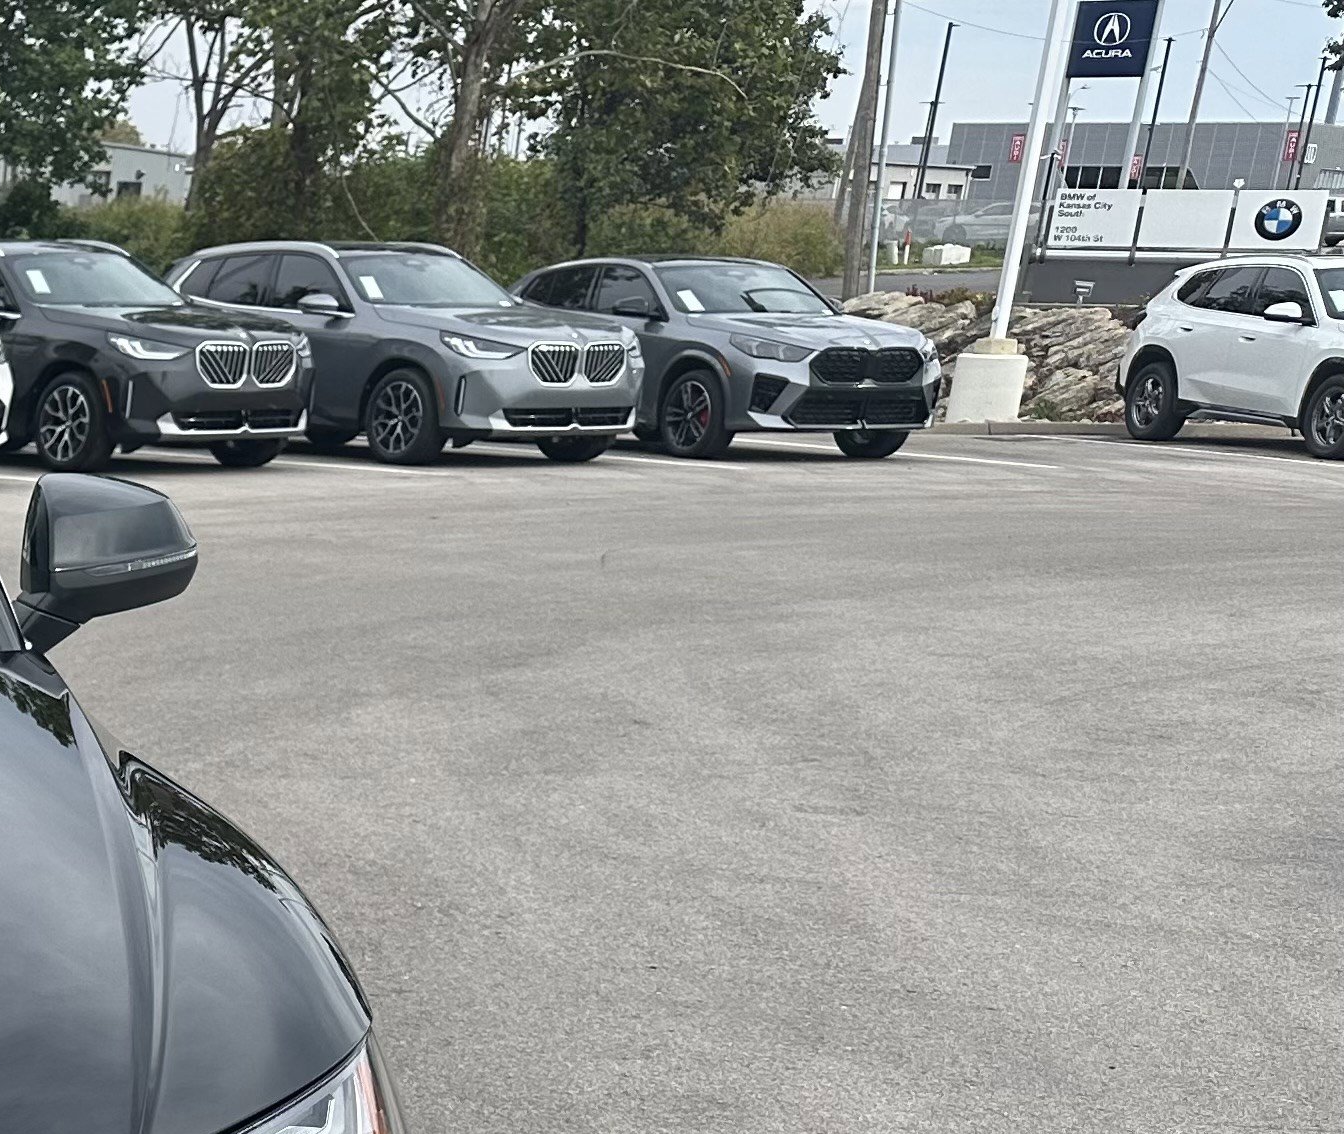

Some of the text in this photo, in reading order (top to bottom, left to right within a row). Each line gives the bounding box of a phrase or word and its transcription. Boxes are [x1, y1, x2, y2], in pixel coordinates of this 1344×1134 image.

[1082, 48, 1132, 58] ACURA
[1087, 193, 1097, 201] of
[1059, 201, 1113, 211] Kansas City
[1053, 234, 1063, 242] W
